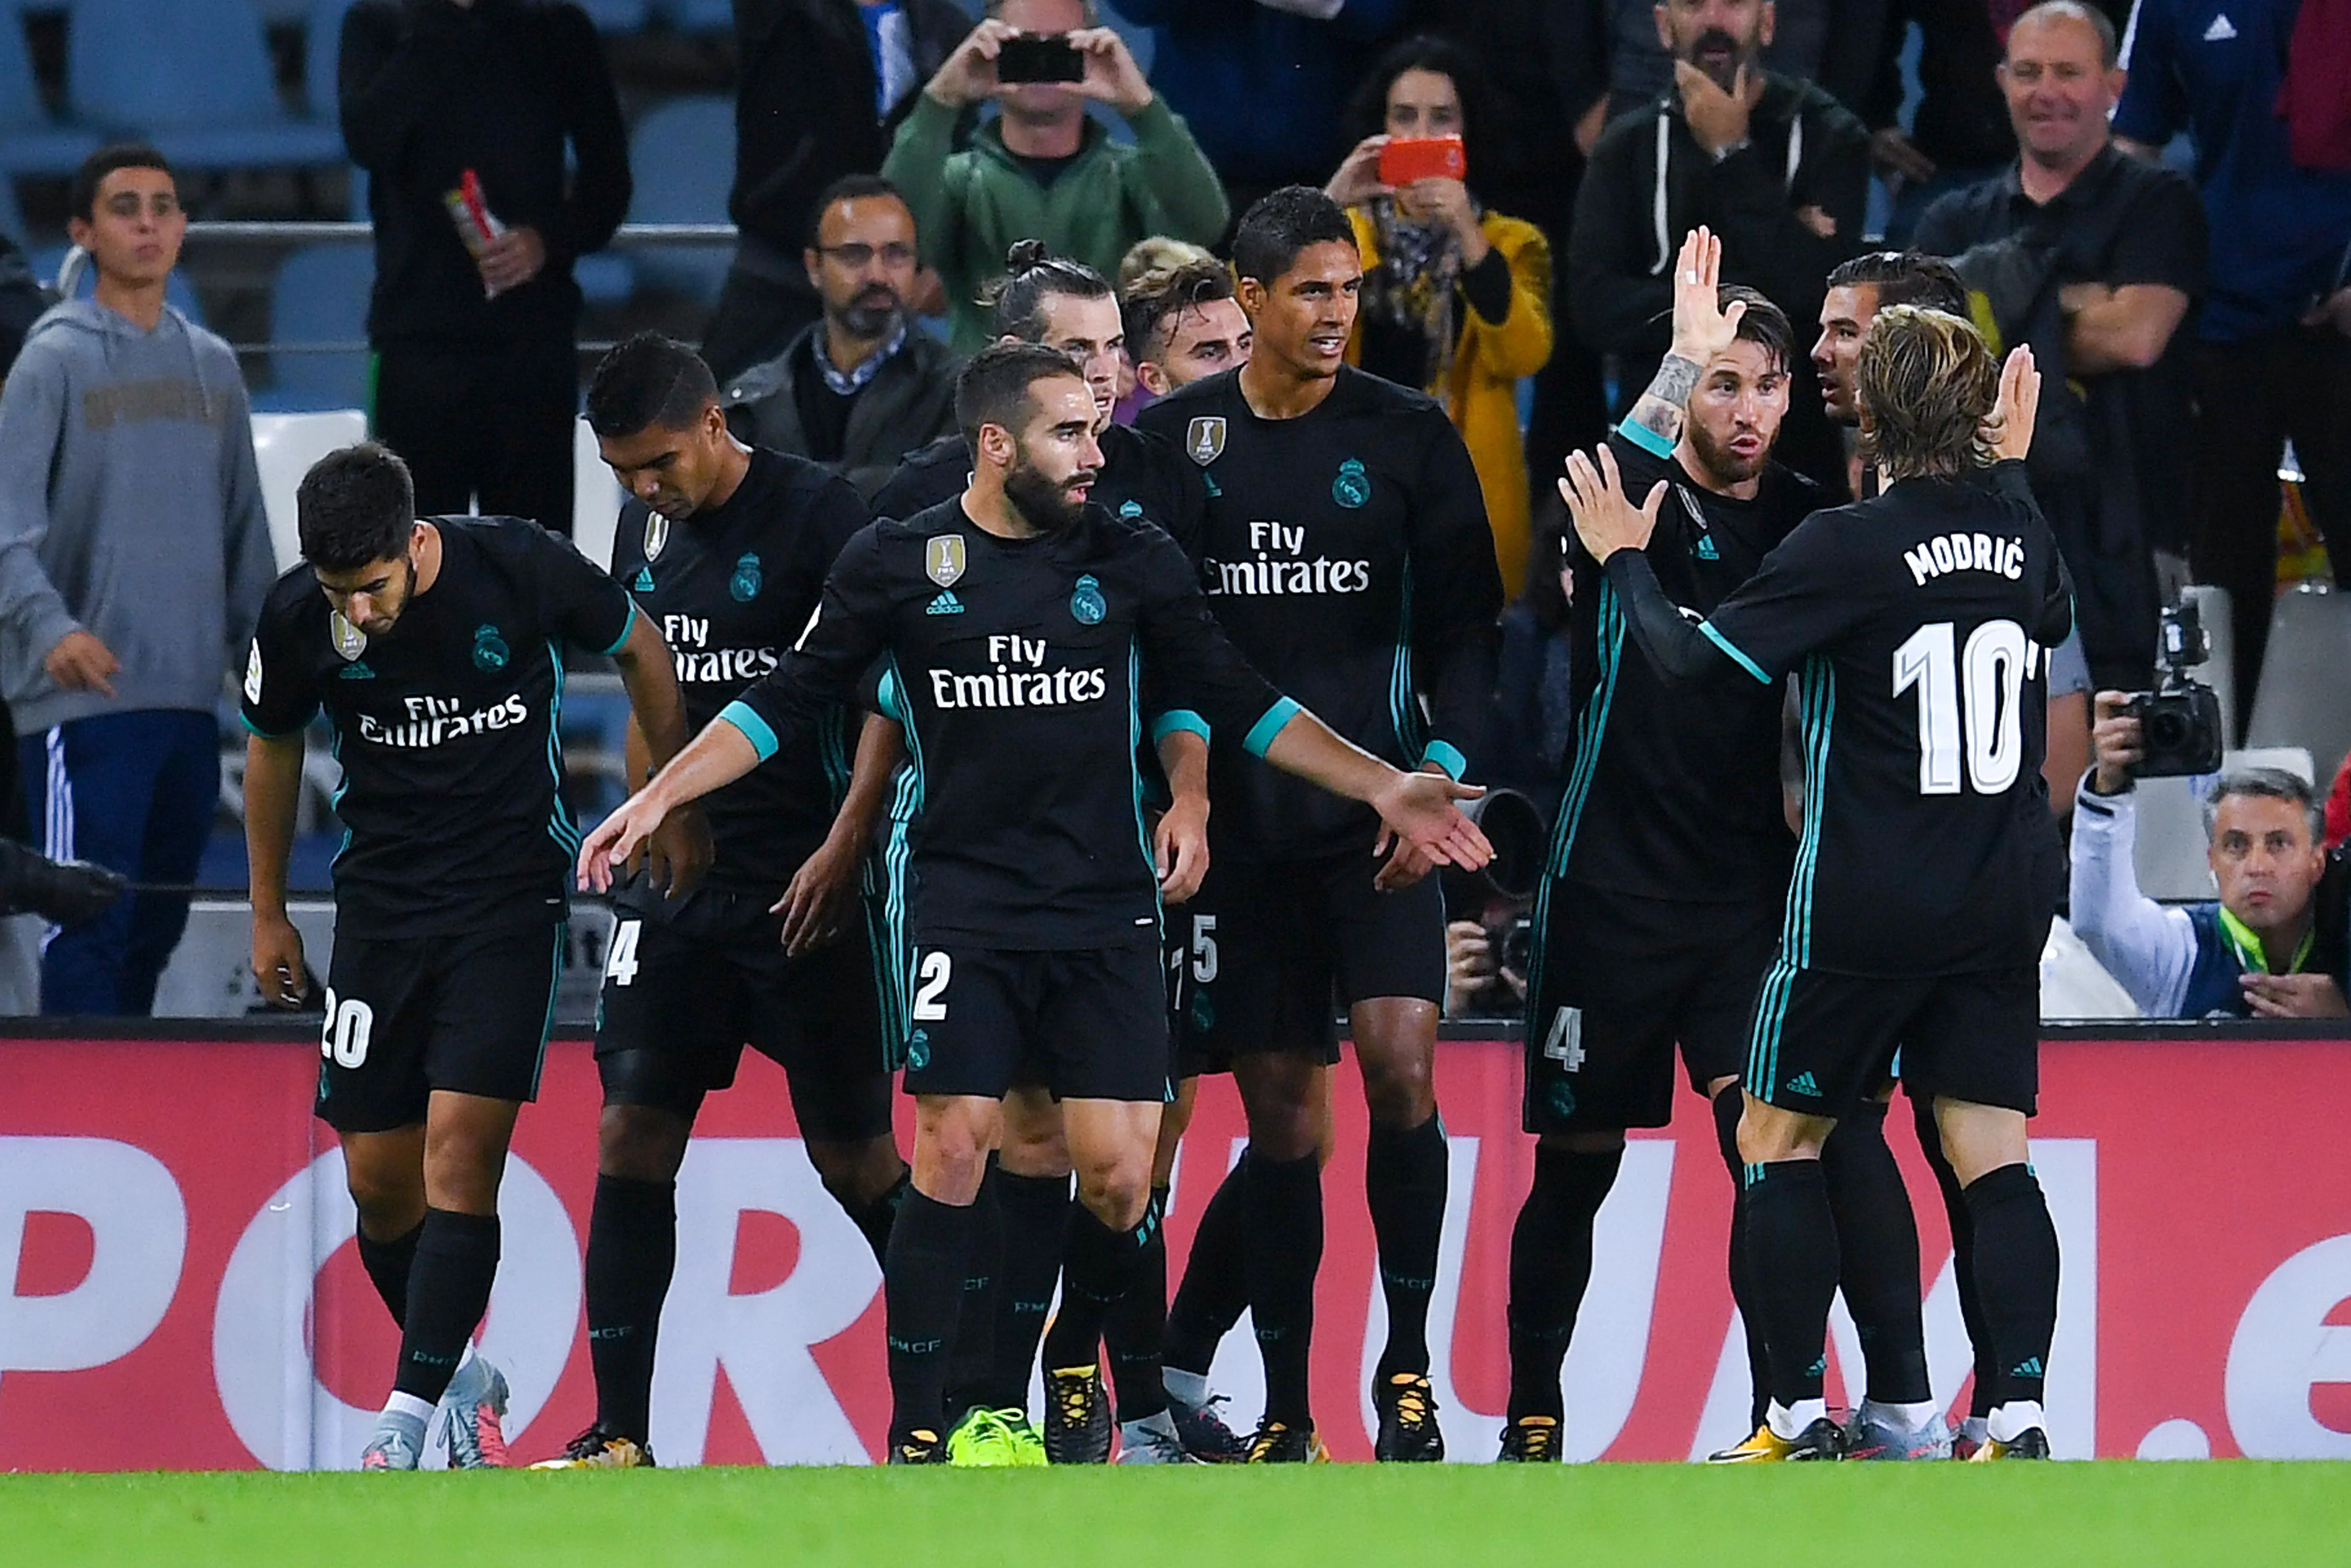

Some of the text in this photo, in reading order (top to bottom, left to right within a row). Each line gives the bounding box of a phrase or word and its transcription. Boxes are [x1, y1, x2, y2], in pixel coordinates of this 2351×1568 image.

[1249, 522, 1305, 555] Fly
[1903, 533, 2024, 586] MODRIĆ
[664, 614, 709, 647] Fly
[988, 634, 1046, 667] Fly
[671, 644, 778, 682] irates
[928, 664, 1105, 708] Emirates
[1892, 619, 2027, 795] 10
[1193, 914, 1218, 983] 5
[913, 951, 951, 1020] 2
[321, 986, 374, 1070] 20
[1544, 1006, 1586, 1073] 4
